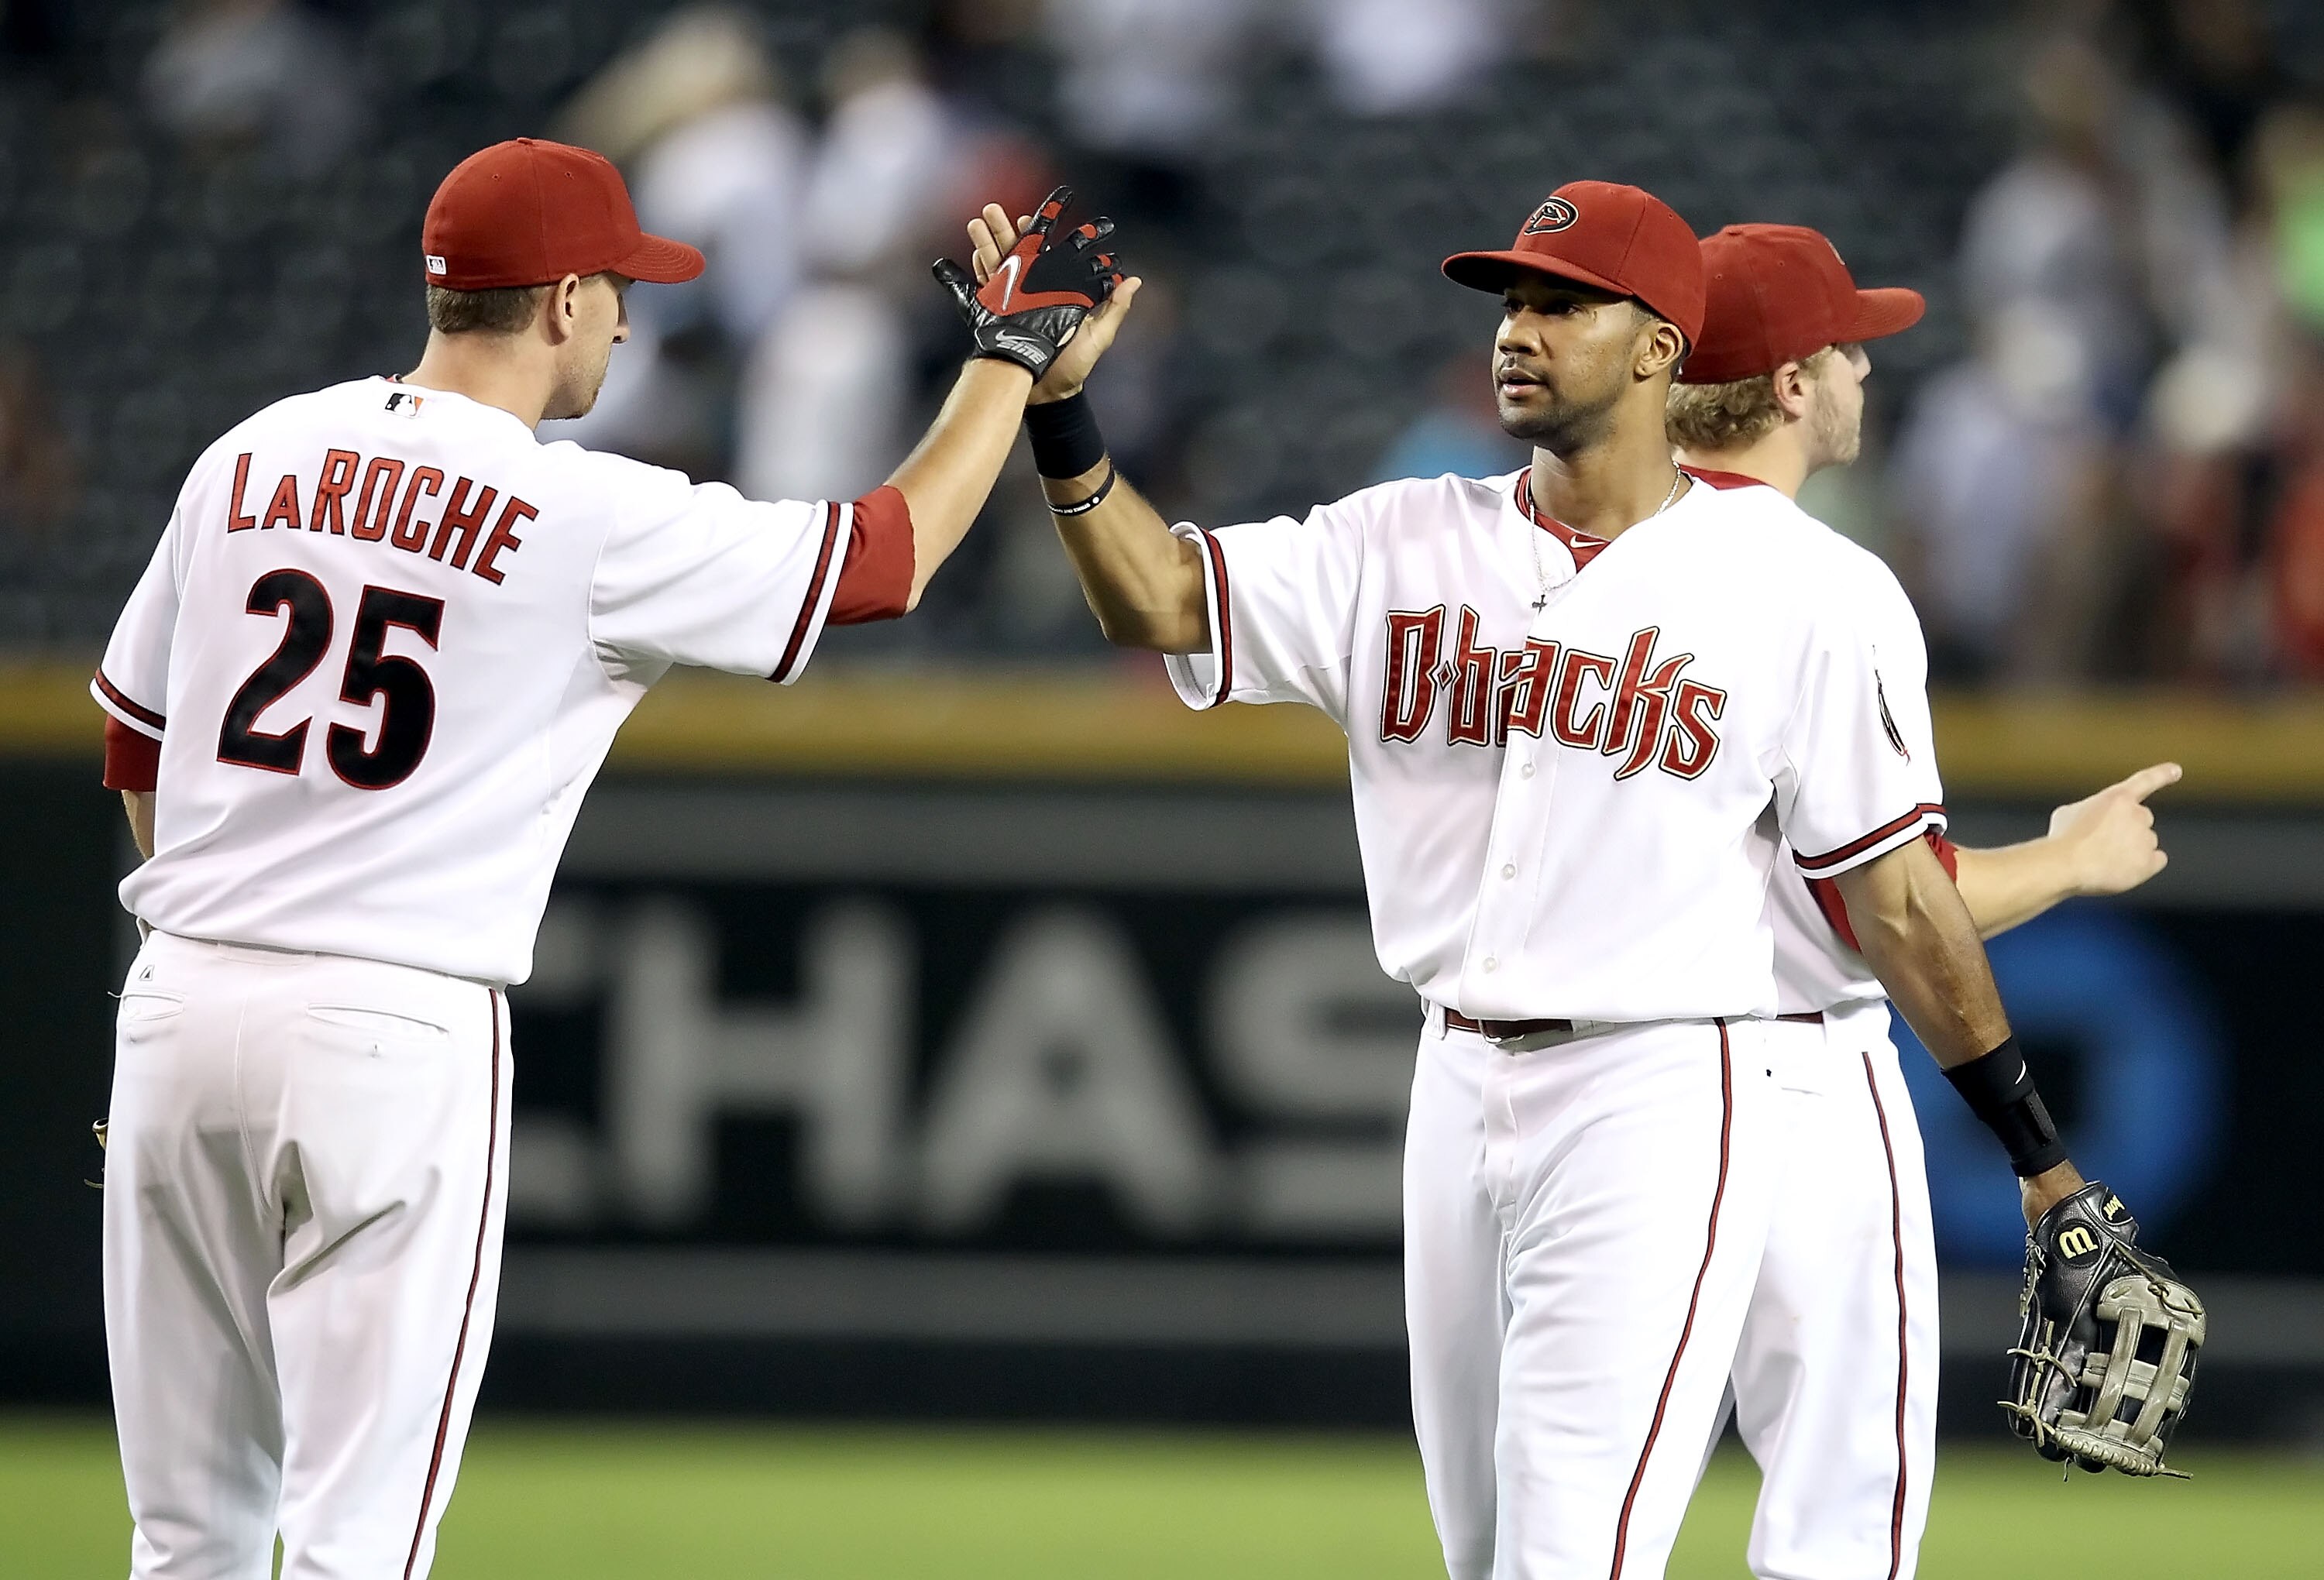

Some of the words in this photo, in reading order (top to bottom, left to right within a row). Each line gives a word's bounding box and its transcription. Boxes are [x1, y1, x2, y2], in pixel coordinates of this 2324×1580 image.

[228, 448, 540, 586] LaROCHE
[216, 568, 445, 791] 25
[511, 902, 1405, 1230] HAS
